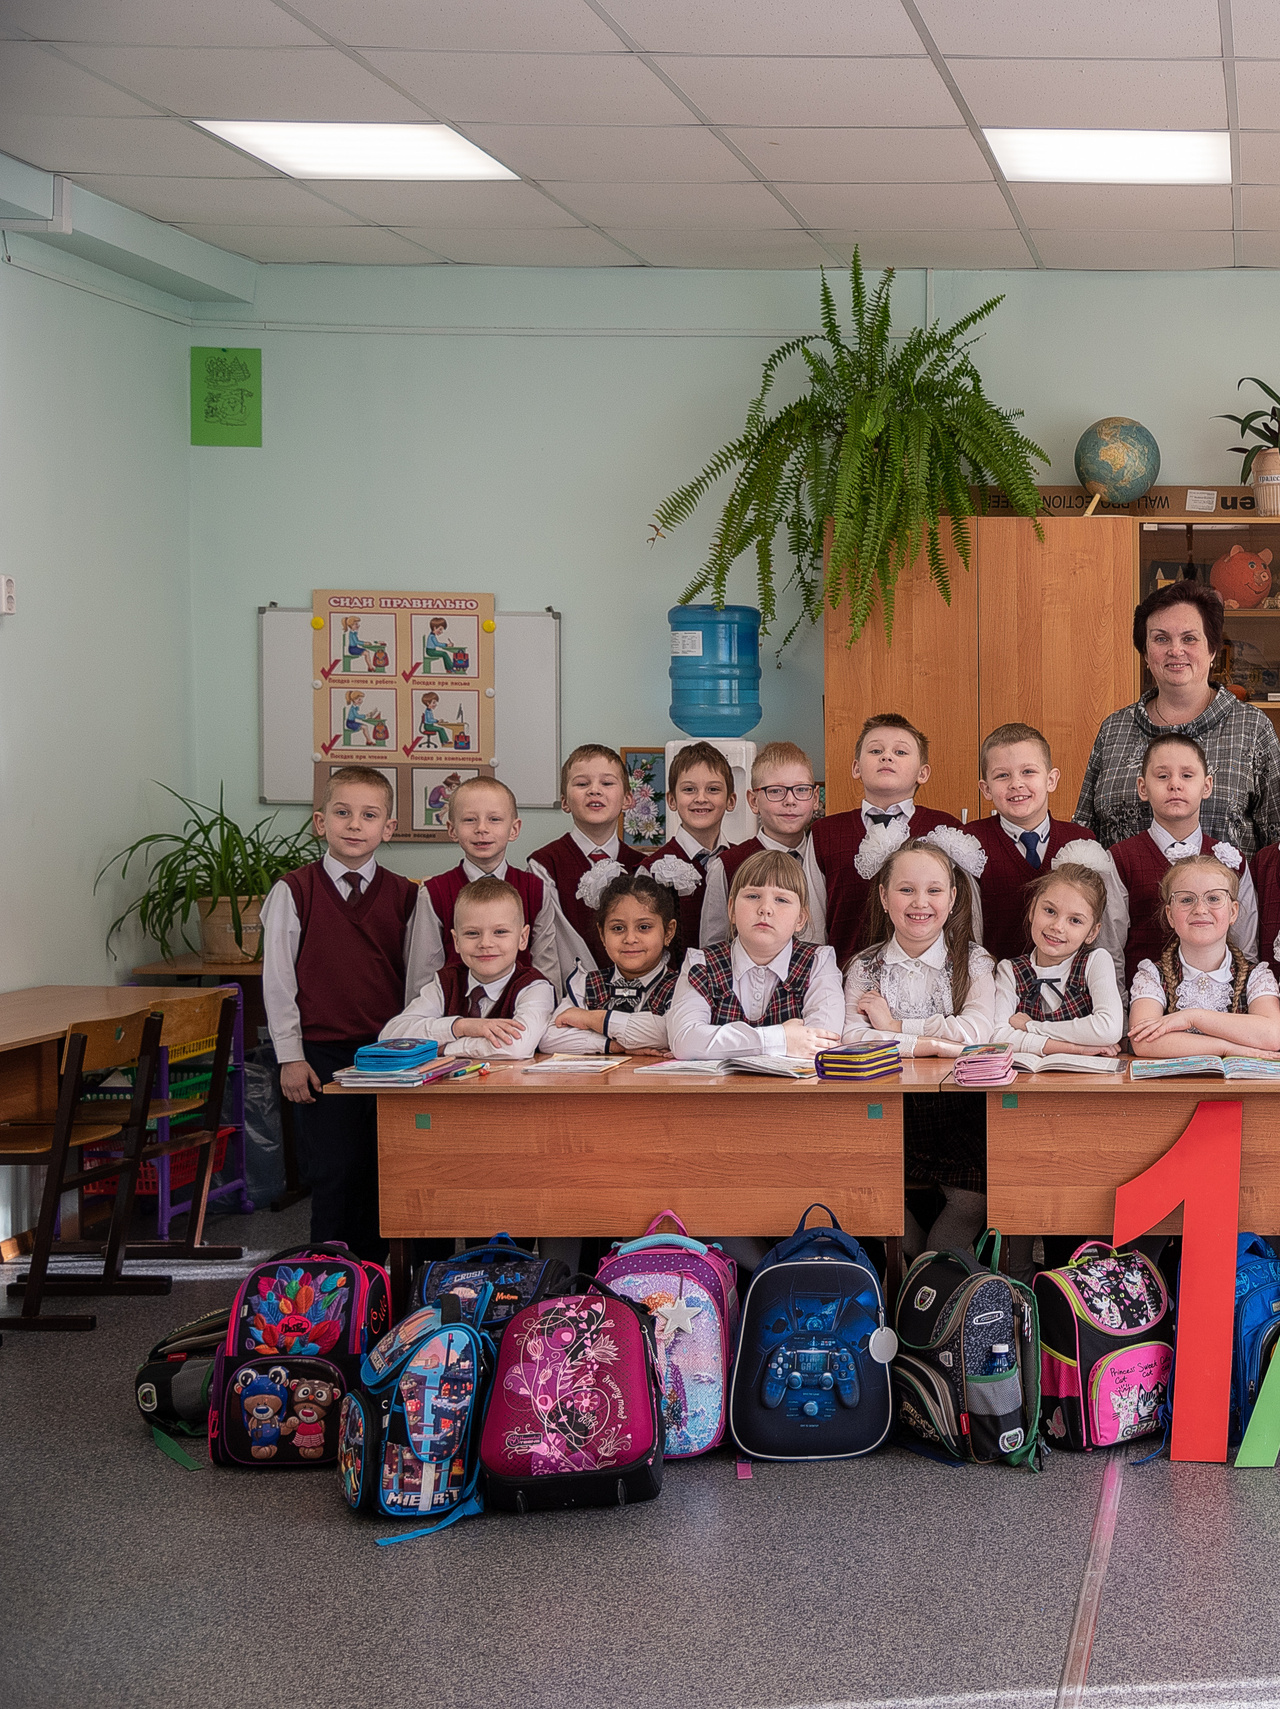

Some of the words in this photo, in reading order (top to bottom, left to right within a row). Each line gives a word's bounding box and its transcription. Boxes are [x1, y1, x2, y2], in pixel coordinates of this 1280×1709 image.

[328, 597, 375, 608] СИДИ
[379, 598, 479, 610] ПРАВИЛЬНО
[454, 1269, 485, 1283] CRUSH
[1109, 1366, 1136, 1377] Princess
[1137, 1360, 1158, 1373] Sweet
